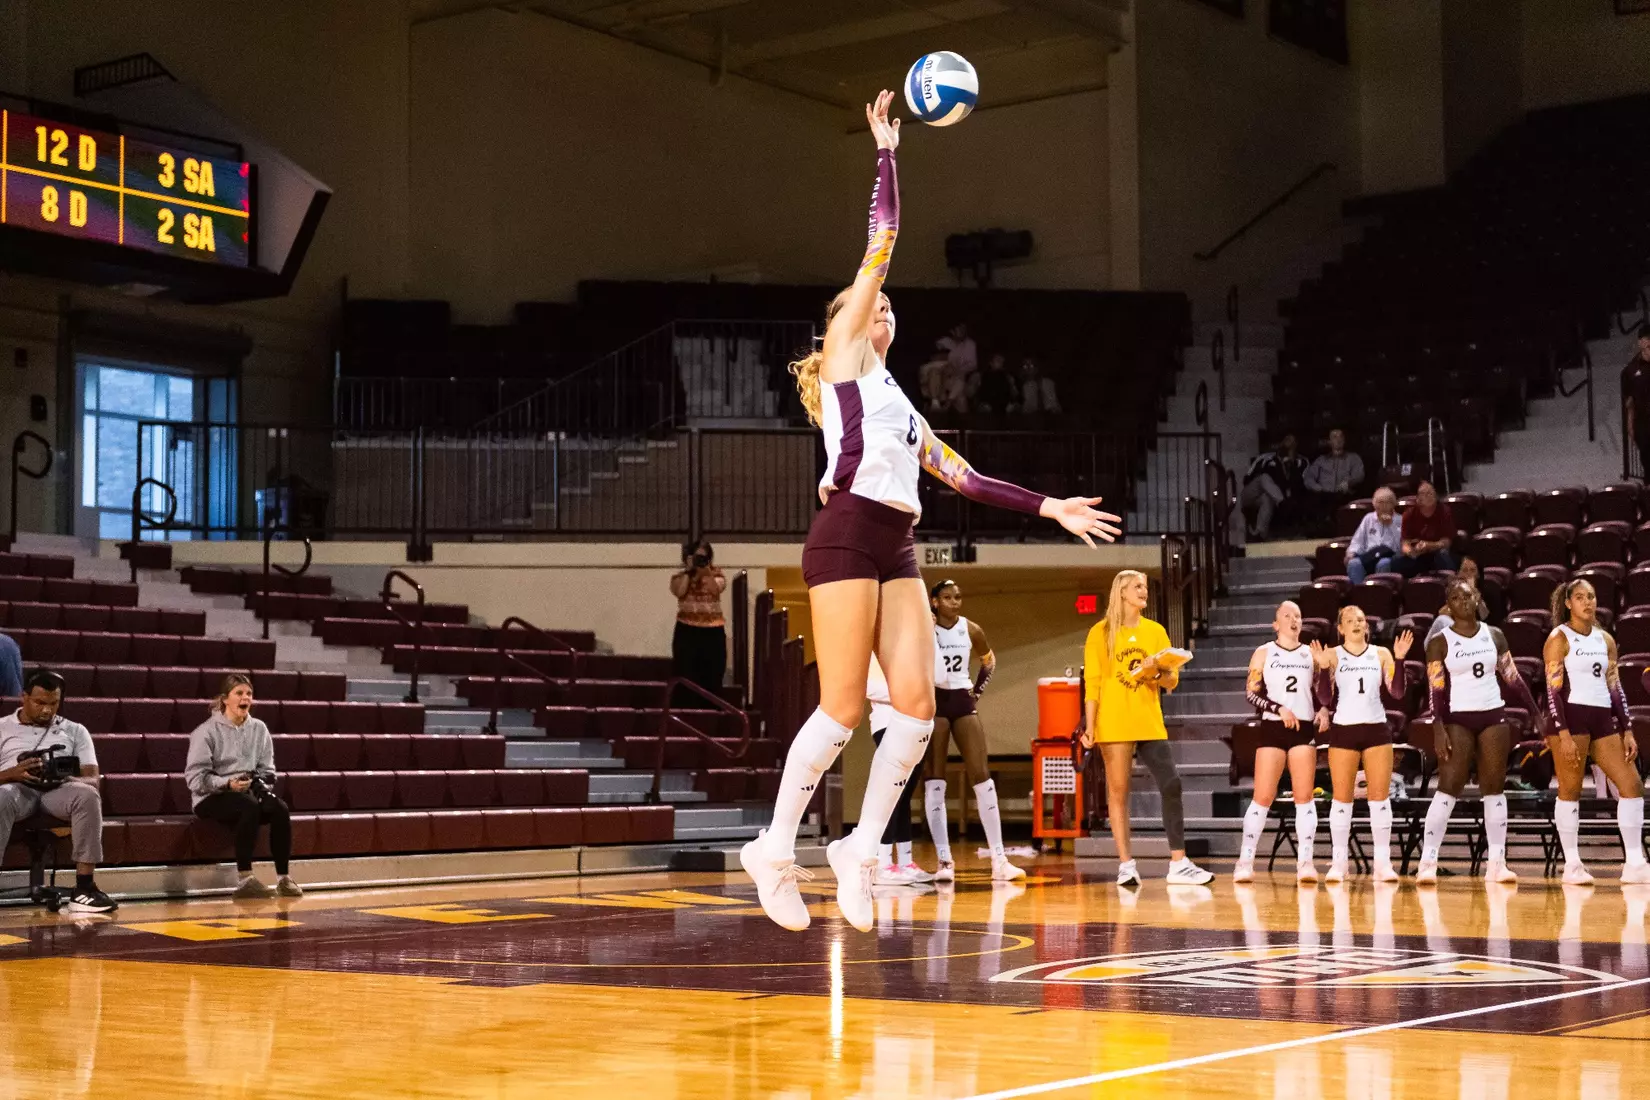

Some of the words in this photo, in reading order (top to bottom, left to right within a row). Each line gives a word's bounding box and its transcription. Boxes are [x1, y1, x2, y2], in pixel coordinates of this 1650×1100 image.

[36, 126, 68, 166] 12
[78, 134, 97, 172] D
[158, 152, 175, 188] 3
[183, 157, 215, 197] SA
[40, 185, 59, 222] 8
[69, 190, 88, 227] D
[157, 208, 174, 244] 2
[183, 212, 215, 252] SA
[925, 548, 949, 564] EXIT
[943, 655, 963, 672] 22
[1472, 662, 1484, 678] 8
[1285, 675, 1298, 693] 2
[1358, 677, 1365, 694] 1
